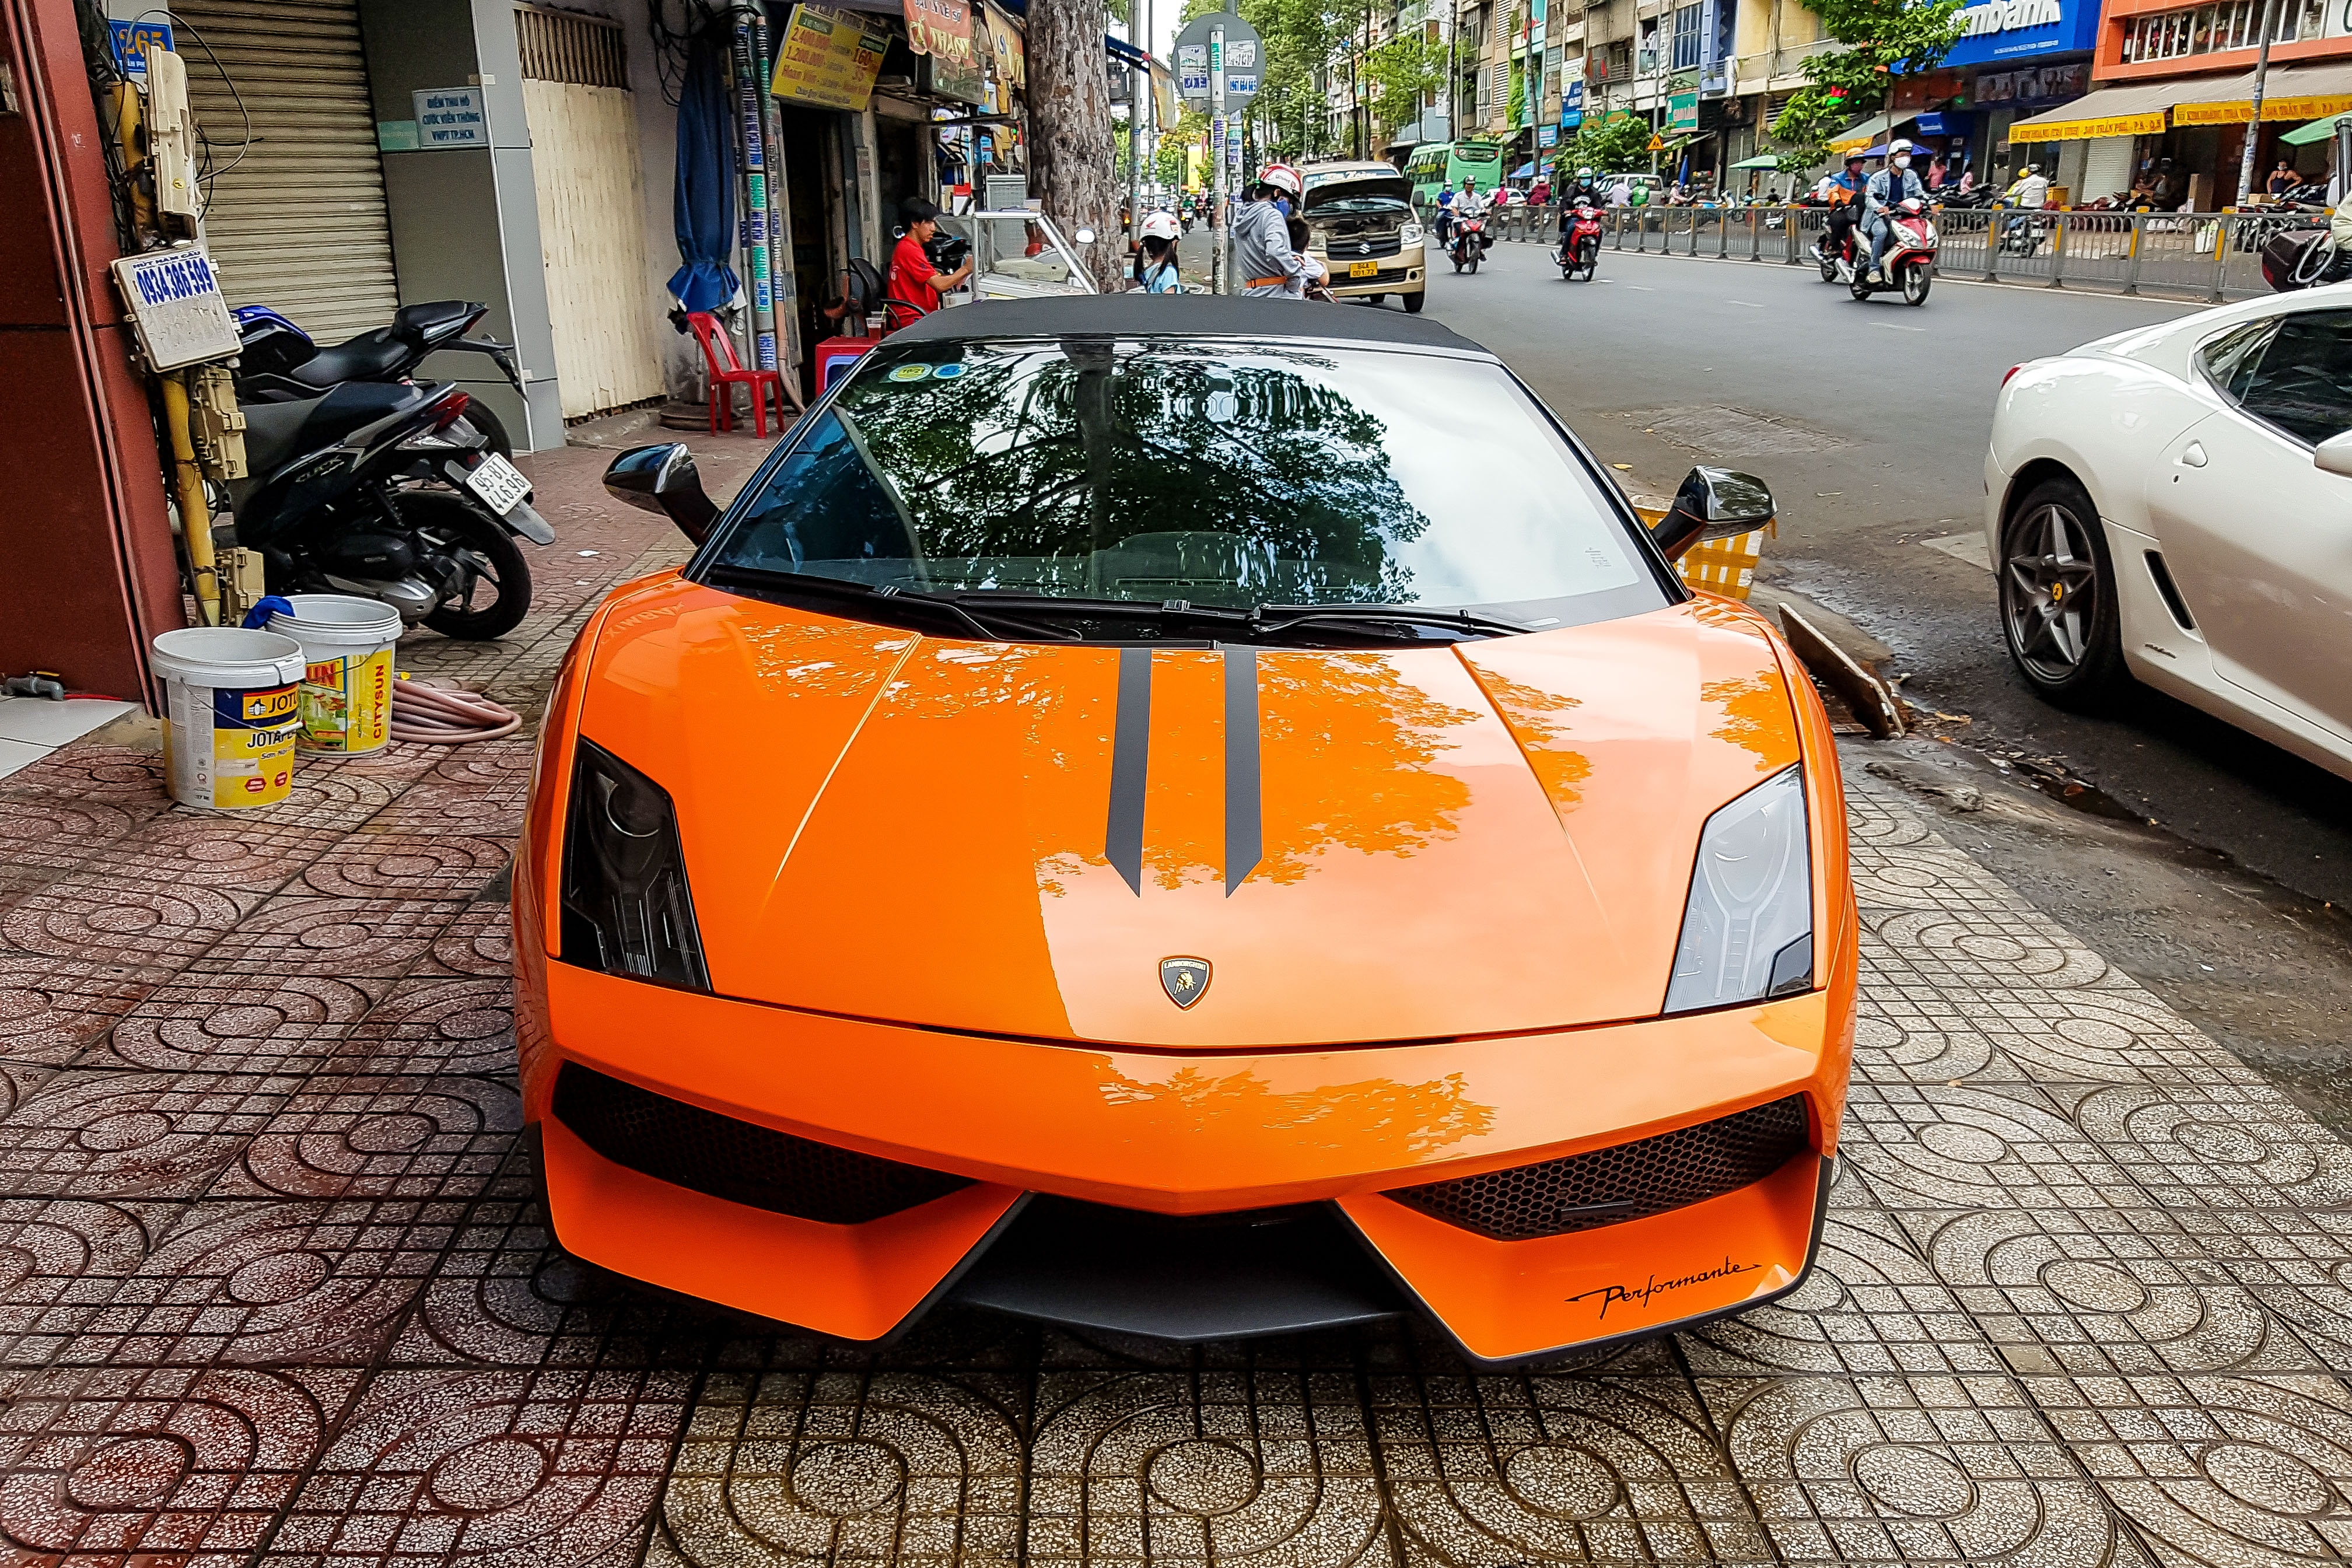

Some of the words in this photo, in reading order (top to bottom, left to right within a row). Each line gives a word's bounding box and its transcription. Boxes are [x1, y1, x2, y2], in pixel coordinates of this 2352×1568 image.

[119, 29, 166, 57] 265
[488, 473, 526, 510] 446.96
[373, 664, 384, 739] CITYSUN
[1164, 960, 1207, 971] LAMBORGHINI
[1564, 1255, 1763, 1320] Performante
